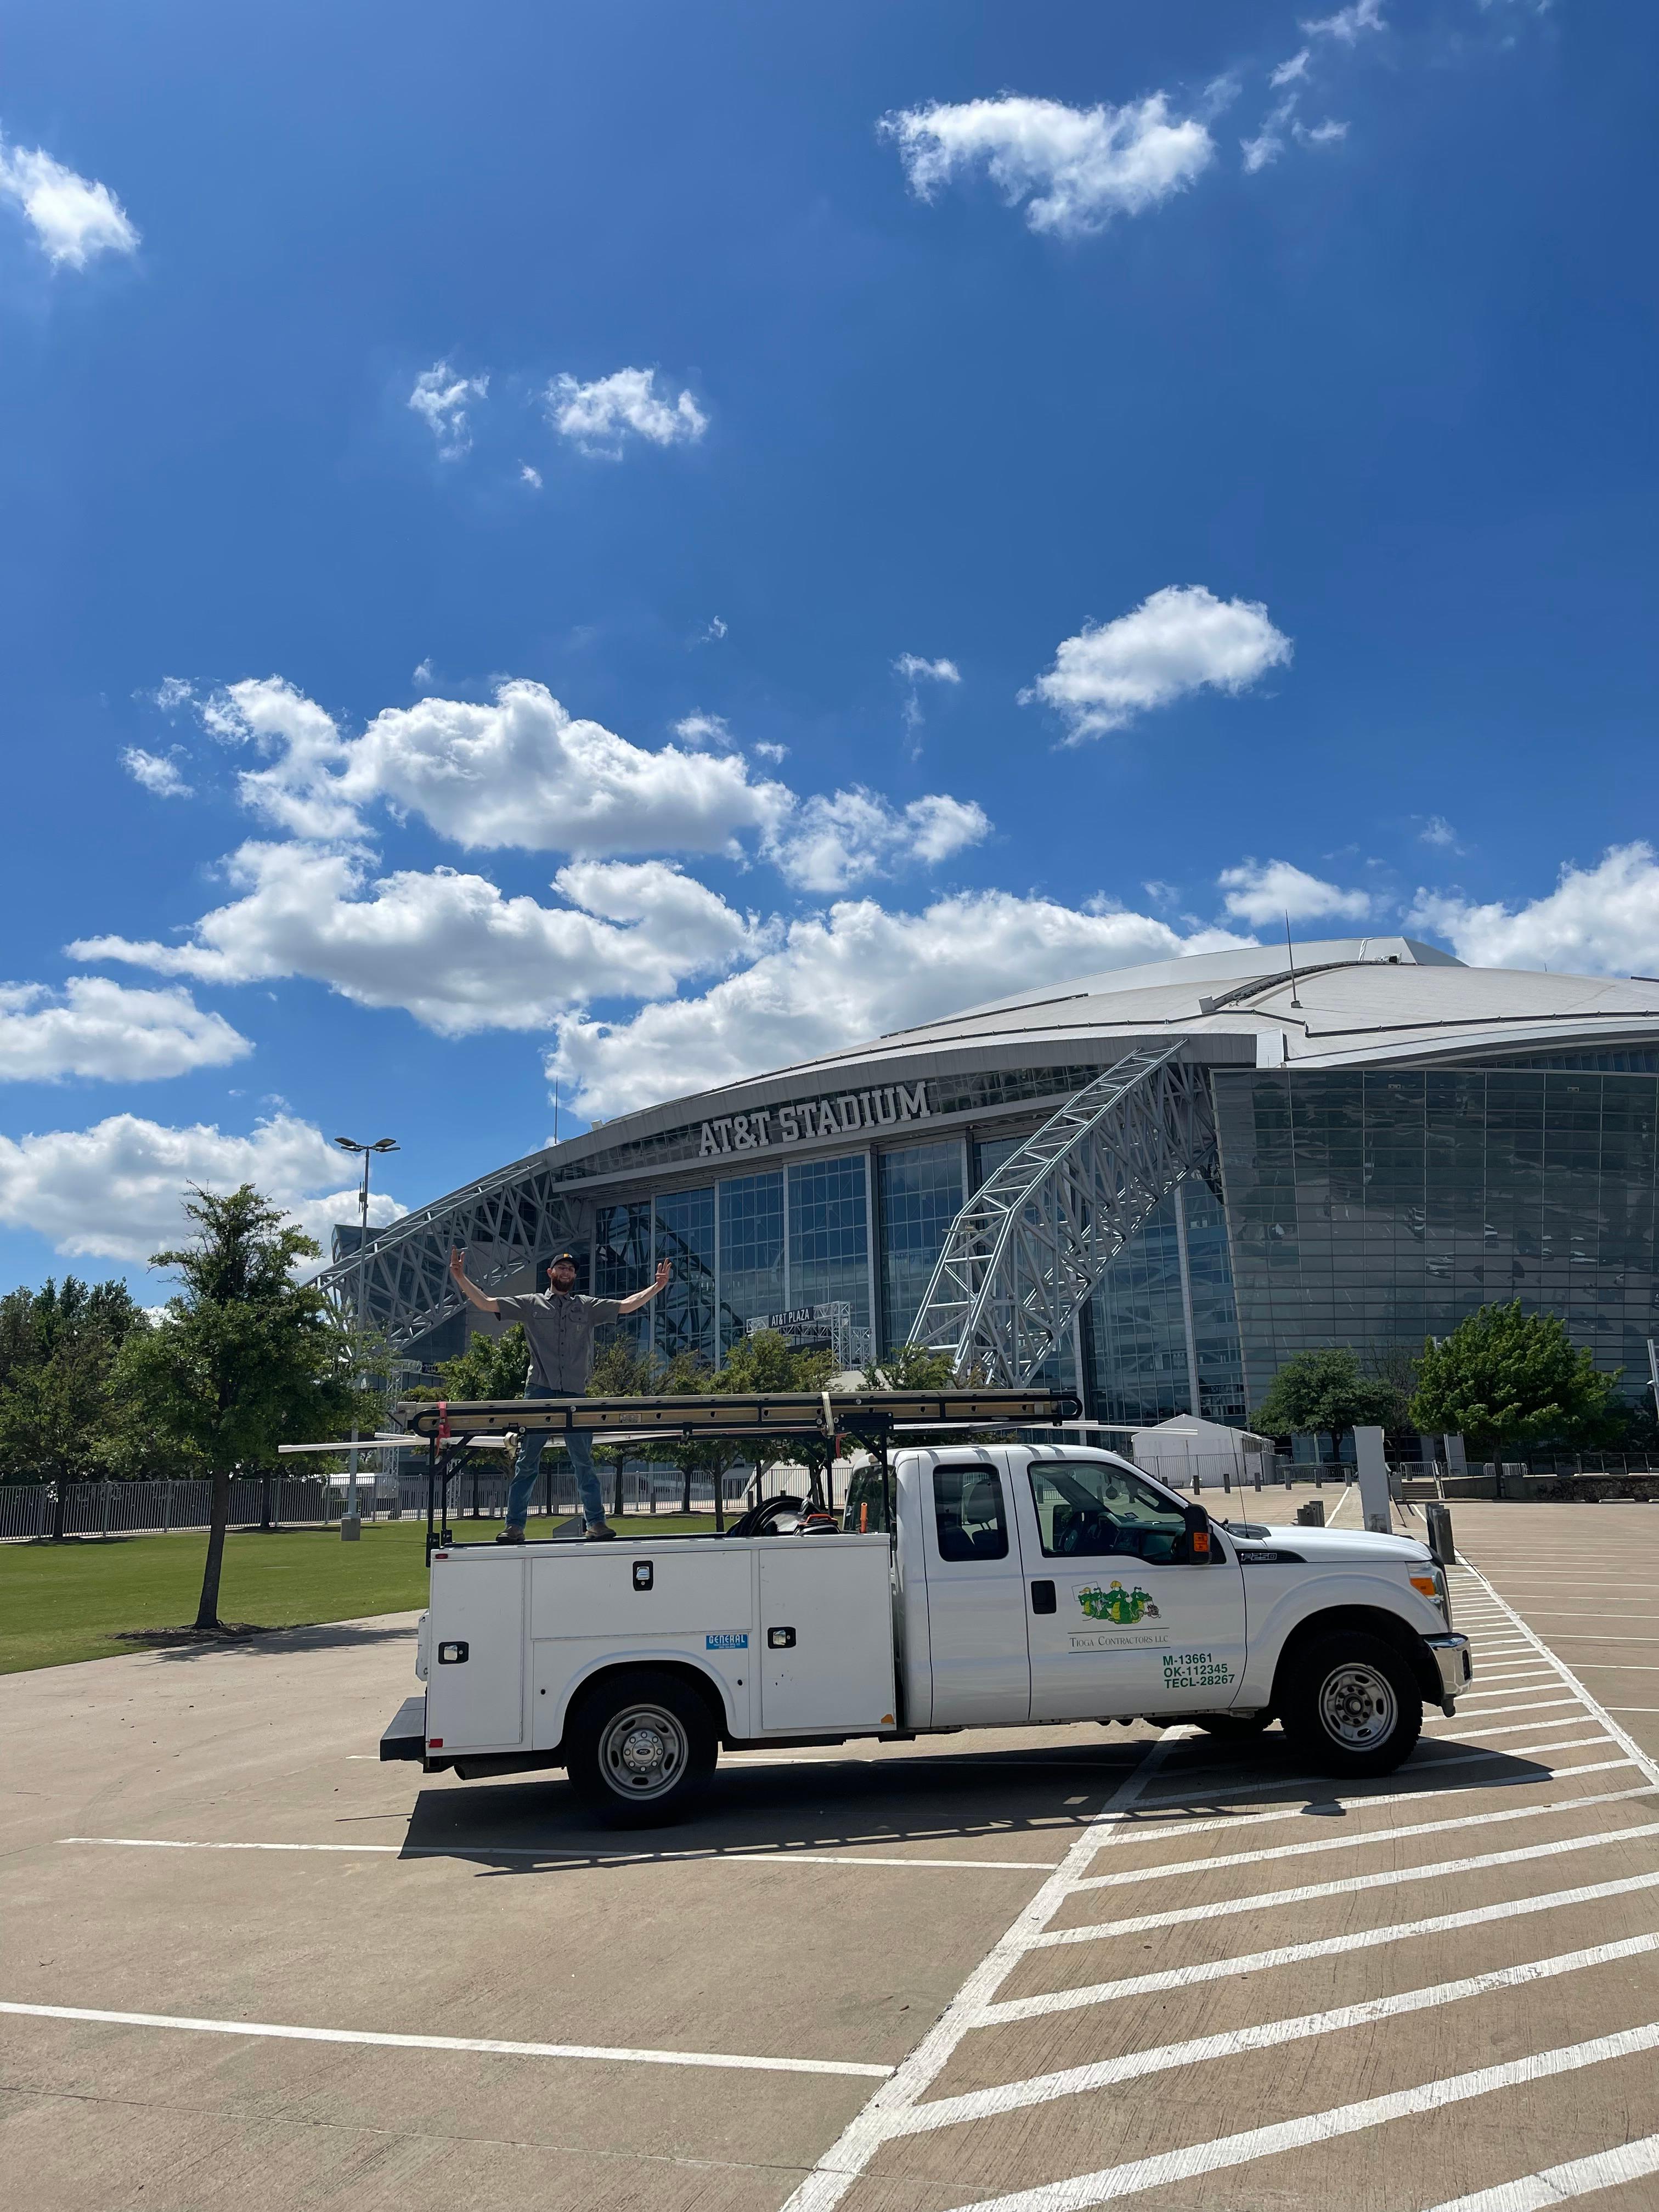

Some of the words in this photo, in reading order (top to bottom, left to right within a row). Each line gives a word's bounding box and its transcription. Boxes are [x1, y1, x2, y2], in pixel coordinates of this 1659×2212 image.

[699, 1111, 770, 1156] AT&T
[779, 1081, 930, 1142] STADIUM
[771, 1313, 787, 1327] AT&T
[789, 1308, 810, 1323] PLAZA
[709, 1634, 745, 1644] GENERAL
[1069, 1638, 1094, 1647] TIOGA
[1098, 1636, 1153, 1646] CONTRACTORS
[1163, 1653, 1211, 1666] M-13661
[1164, 1663, 1228, 1678] OK-112345
[1164, 1674, 1235, 1689] TECL-28267
